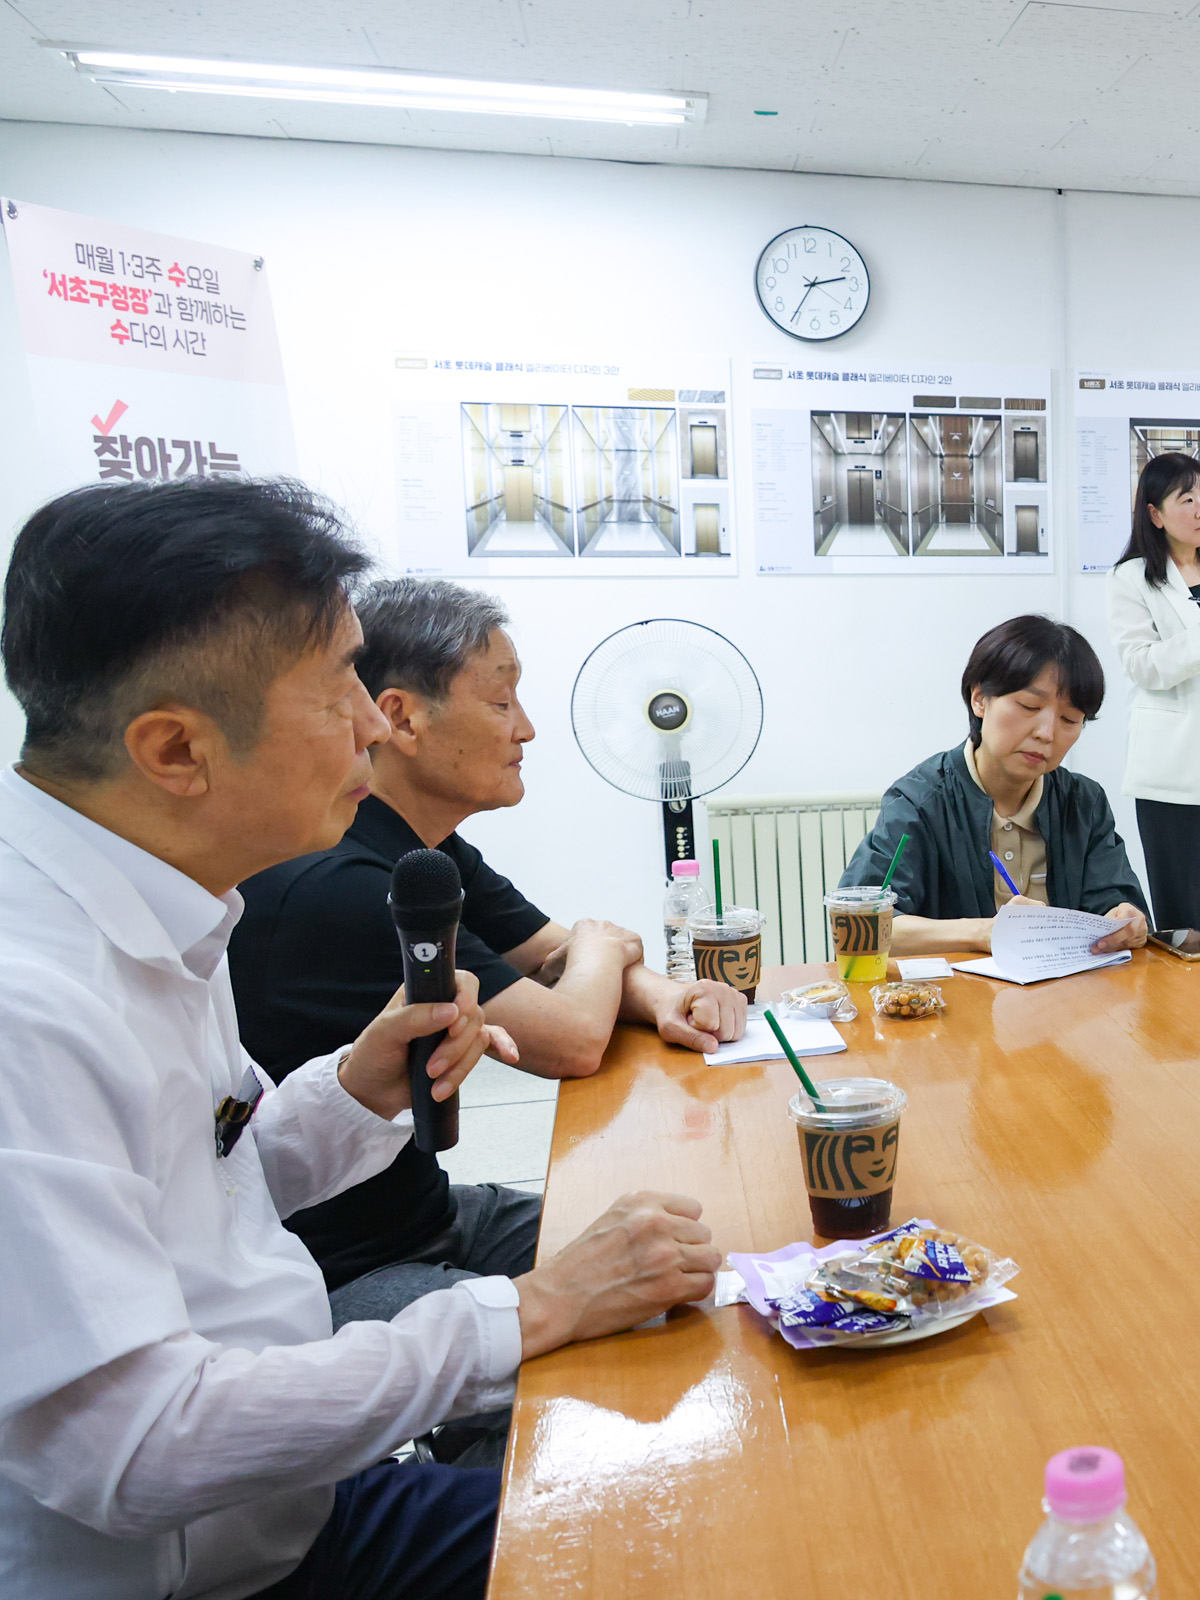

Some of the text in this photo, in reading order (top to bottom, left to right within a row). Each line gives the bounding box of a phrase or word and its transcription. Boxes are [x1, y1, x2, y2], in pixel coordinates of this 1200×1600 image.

[786, 243, 798, 259] 11
[803, 237, 817, 254] 12
[828, 242, 832, 258] 1
[75, 243, 115, 275] 매월
[167, 262, 220, 295] 수요일
[772, 258, 789, 274] 10
[840, 257, 851, 272] 2
[765, 276, 776, 291] 9
[849, 276, 859, 292] 3
[775, 296, 785, 312] 8
[843, 297, 853, 310] 4
[176, 295, 246, 330] 함께하는
[829, 310, 840, 325] 5
[810, 315, 821, 331] 6
[110, 318, 206, 356] 수다의 시간
[868, 373, 910, 384] 엘리베이터
[911, 374, 936, 384] 디자인
[937, 375, 952, 385] 2안
[656, 706, 680, 717] HAAN
[422, 948, 430, 958] 1
